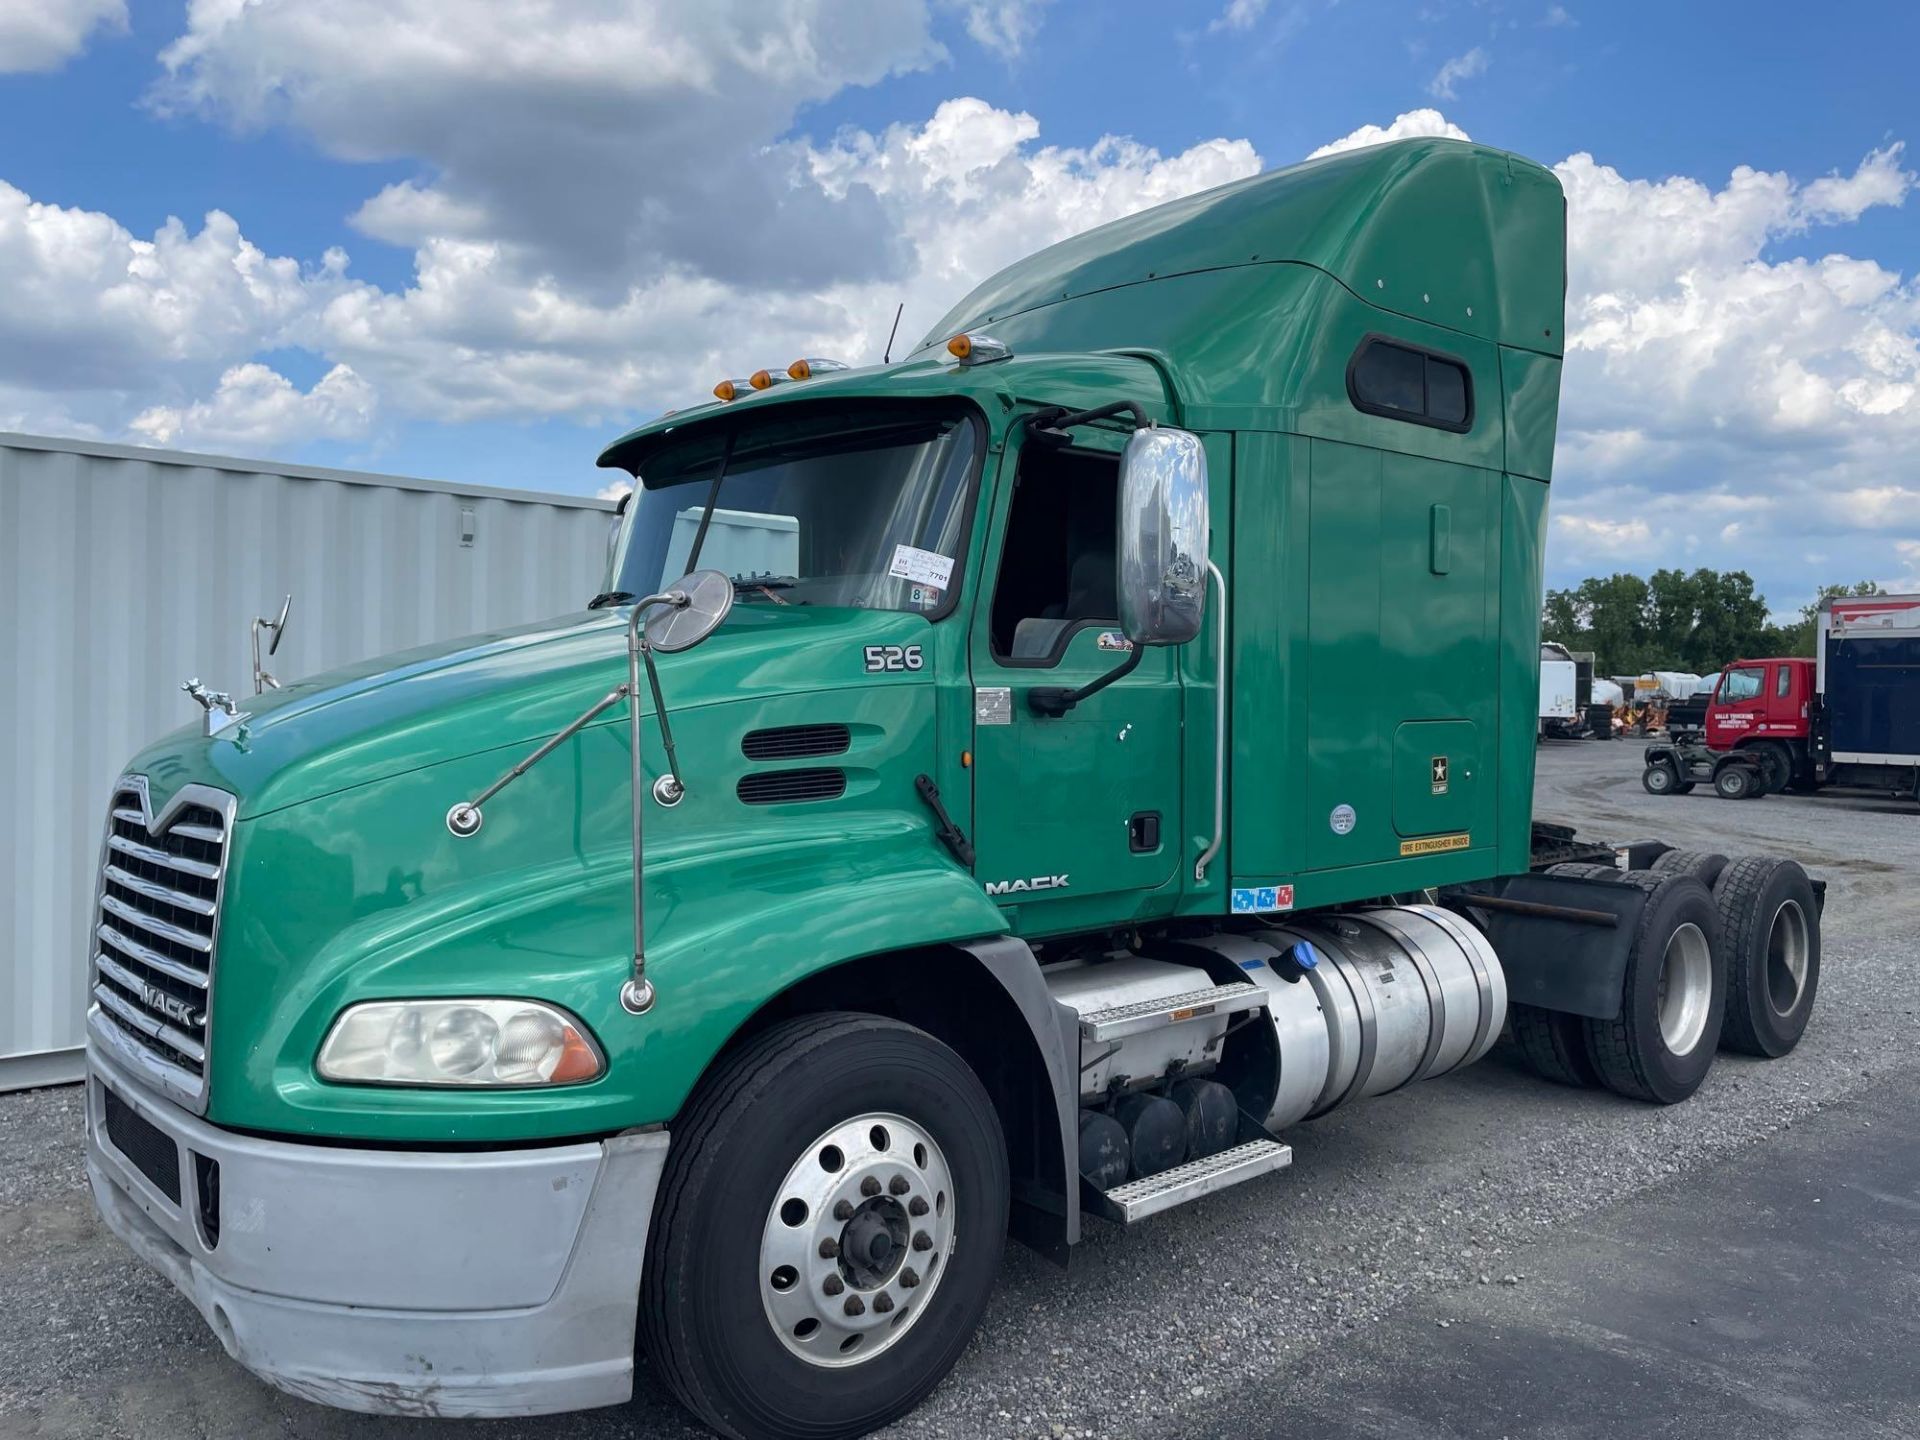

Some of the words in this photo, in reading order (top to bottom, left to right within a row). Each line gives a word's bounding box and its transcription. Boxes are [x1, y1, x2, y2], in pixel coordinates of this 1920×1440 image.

[929, 571, 948, 582] 7701
[913, 588, 921, 600] 8
[864, 645, 924, 671] 526
[1402, 844, 1414, 853] FIRE
[1415, 838, 1452, 852] EXTINGUISHER
[1452, 837, 1469, 847] INSIDE
[985, 874, 1070, 895] MACK
[140, 985, 194, 1026] MACK
